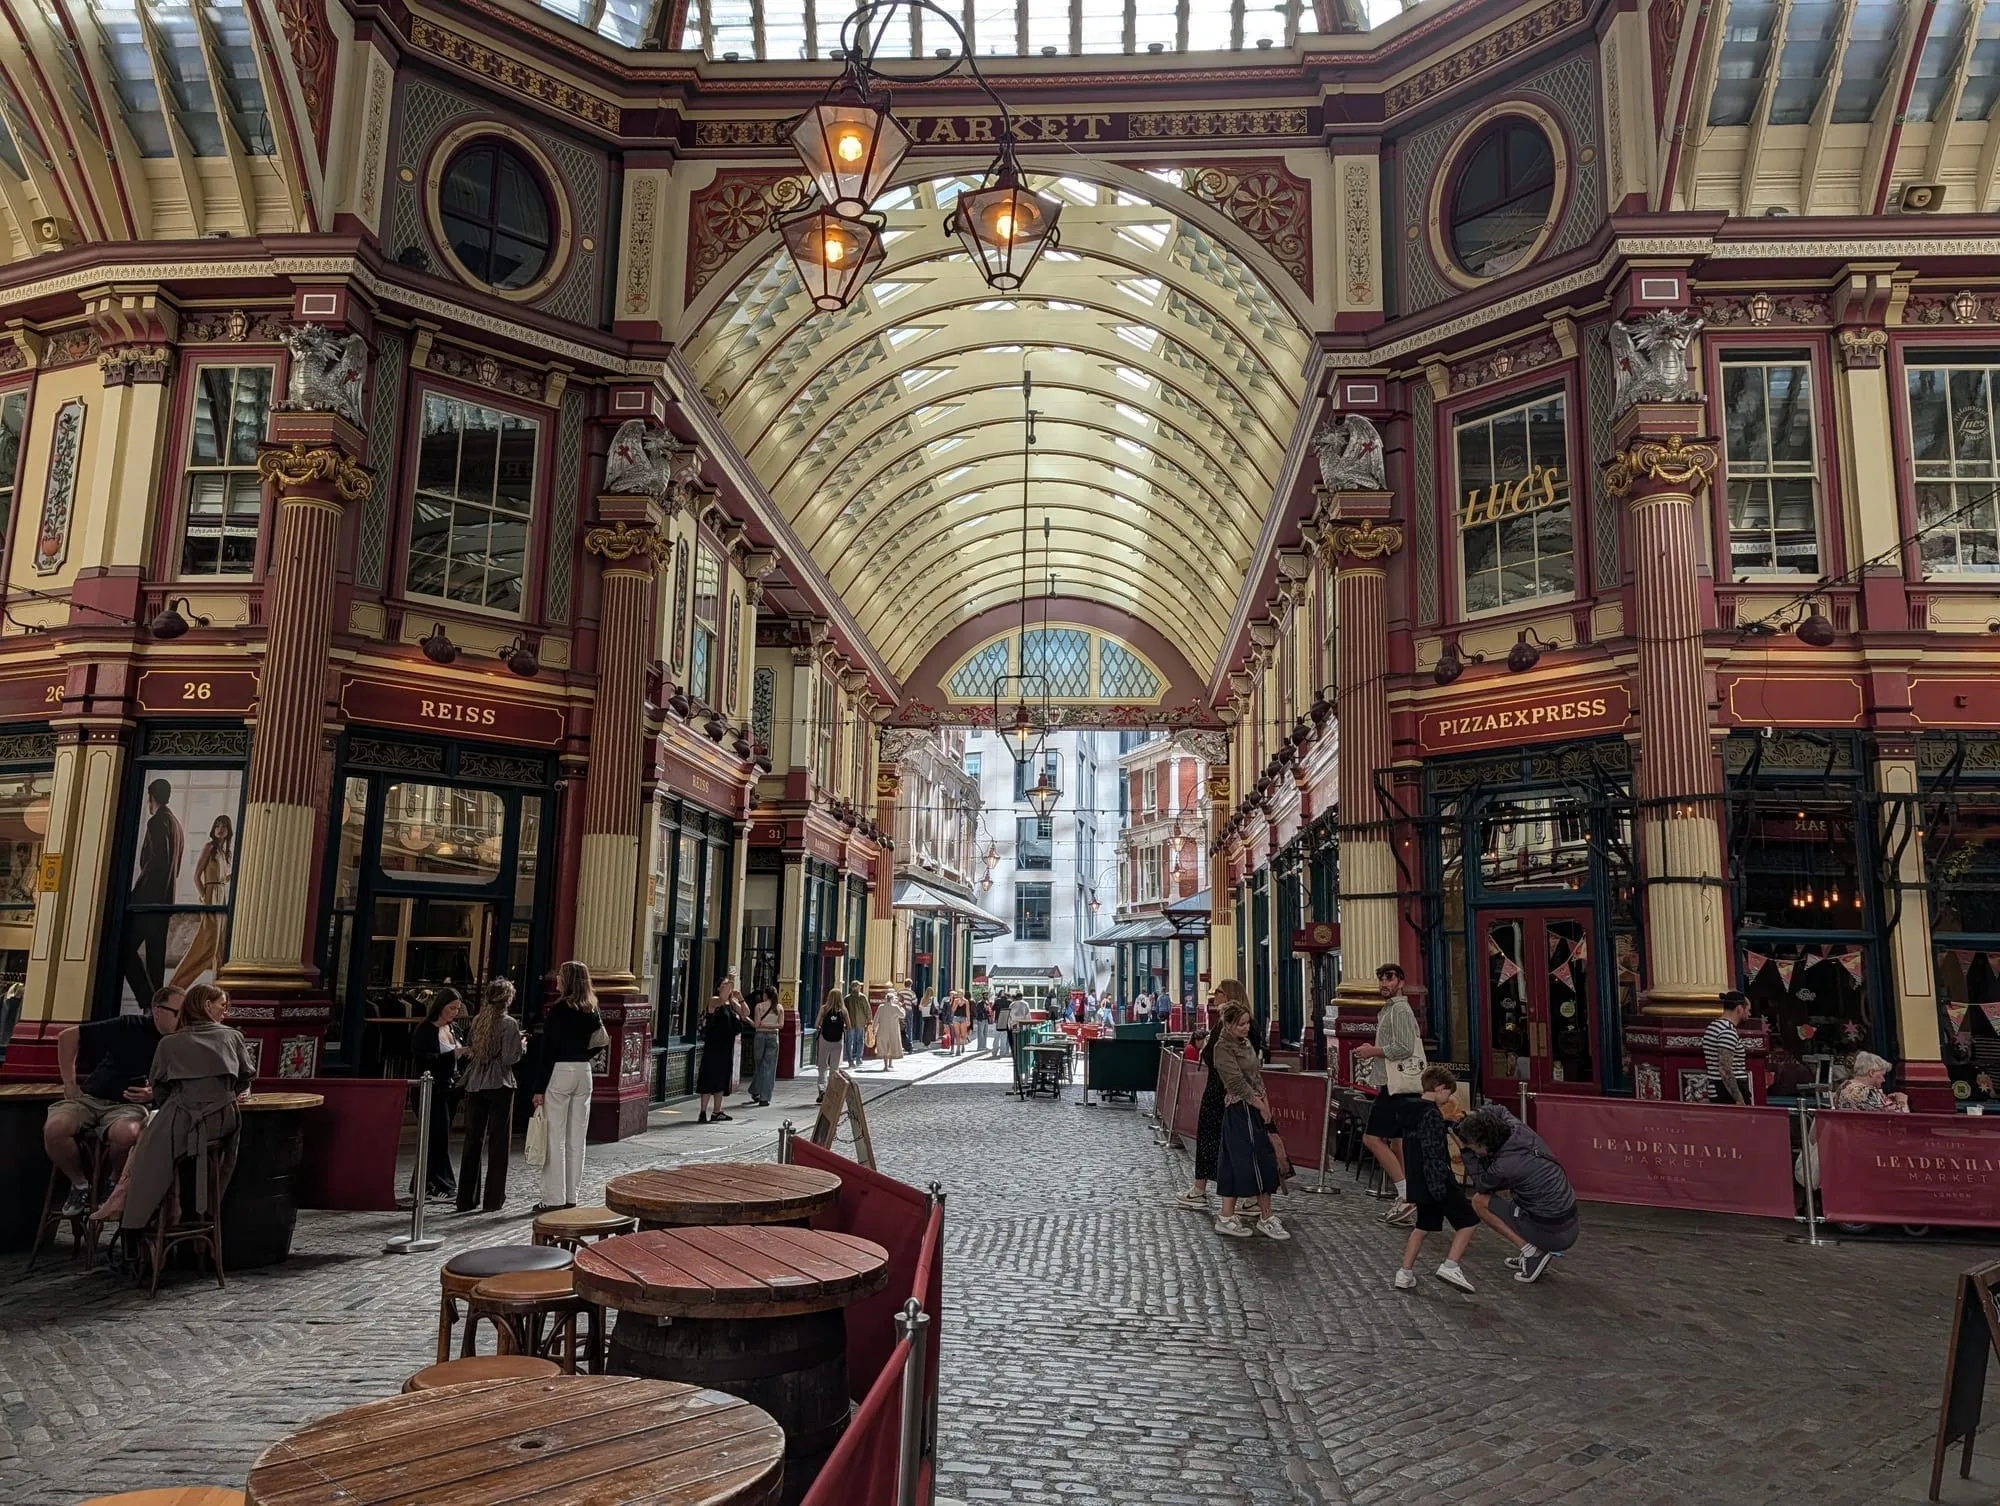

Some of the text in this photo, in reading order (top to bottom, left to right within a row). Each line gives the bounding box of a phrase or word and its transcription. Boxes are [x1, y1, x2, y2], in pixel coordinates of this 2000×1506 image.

[1463, 465, 1558, 527] LUC'S
[182, 682, 212, 700] 26
[420, 699, 496, 725] REISS
[1439, 698, 1607, 737] PIZZAEXPRESS
[692, 774, 710, 794] REISS
[768, 829, 781, 839] 31
[1592, 1137, 1743, 1160] LEADENHALL
[1624, 1155, 1705, 1169] MARKET
[1876, 1155, 2000, 1171] LEADENHA
[1908, 1172, 1987, 1184] MARKET
